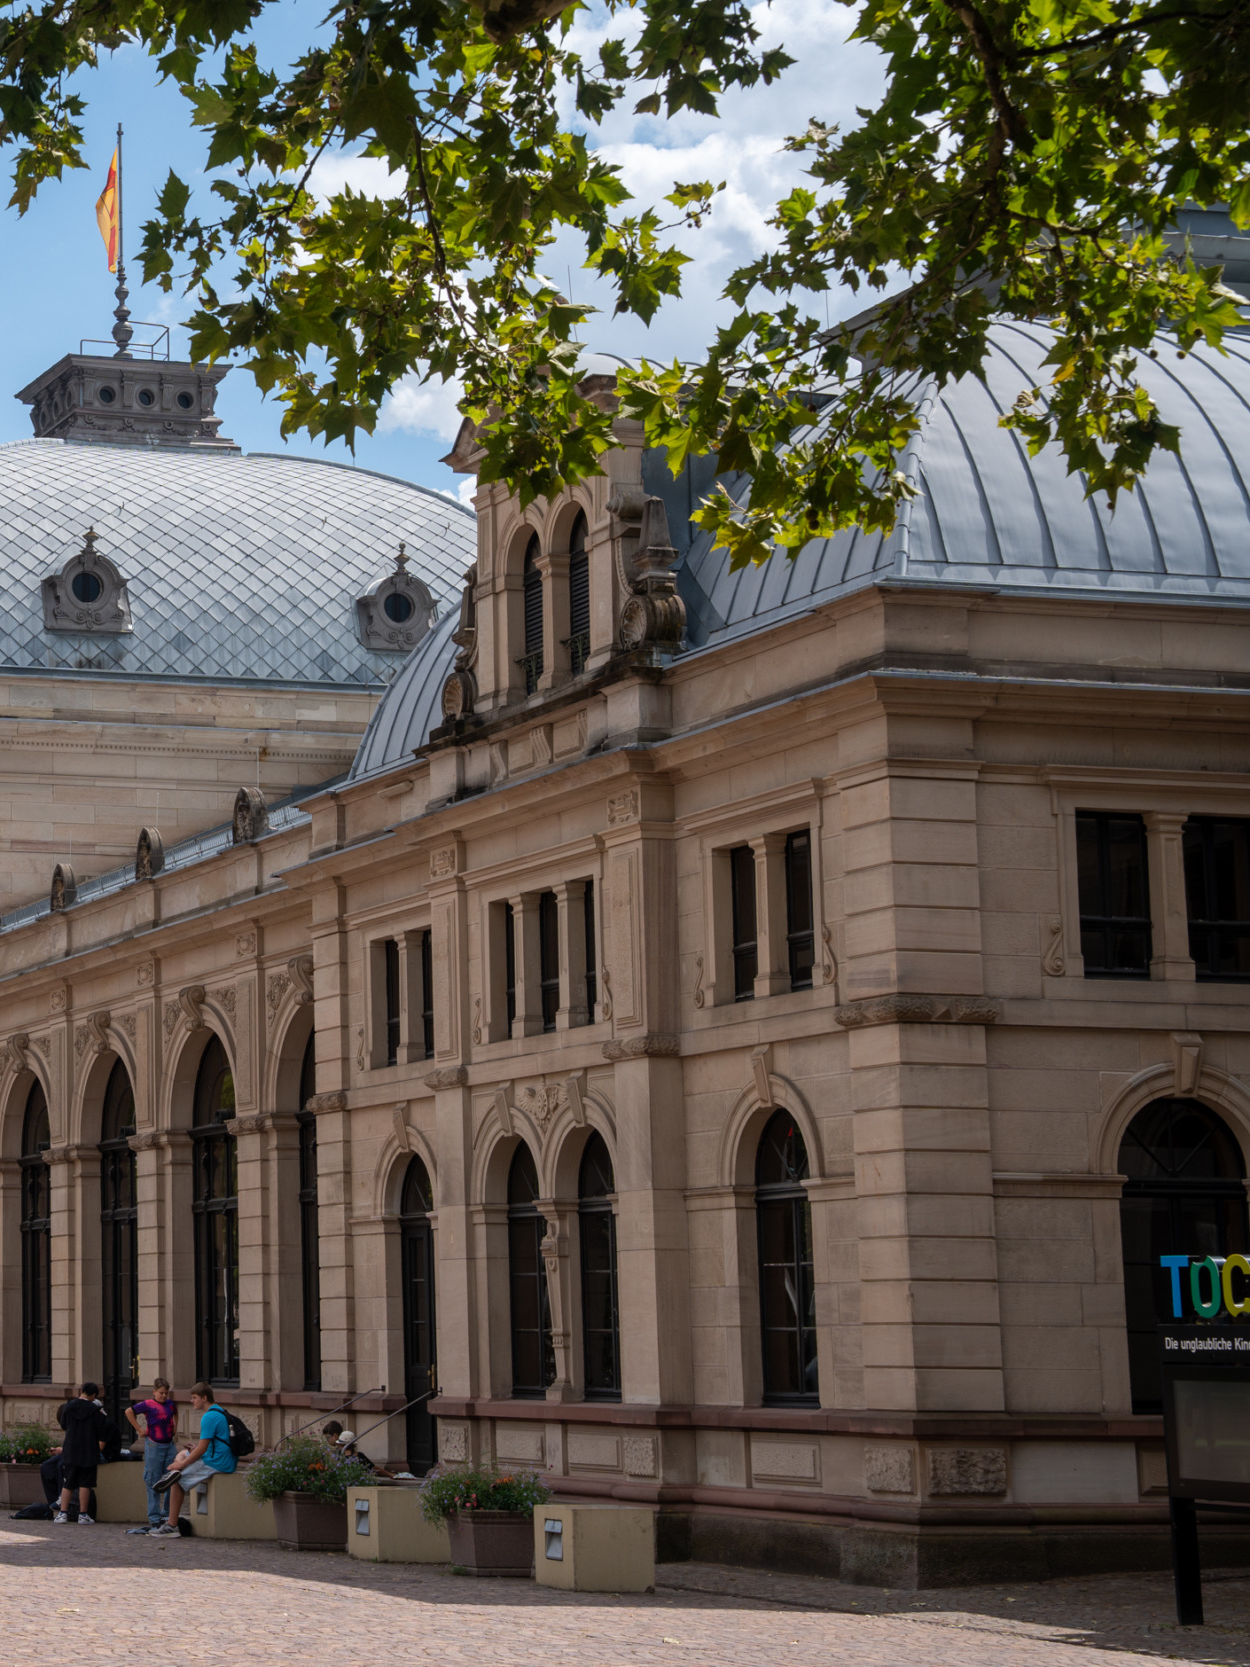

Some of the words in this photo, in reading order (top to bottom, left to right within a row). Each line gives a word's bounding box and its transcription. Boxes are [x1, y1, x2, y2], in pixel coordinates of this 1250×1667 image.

[1164, 1337, 1179, 1350] Die
[1180, 1337, 1232, 1353] unglaubliche
[1234, 1337, 1250, 1351] Kin
